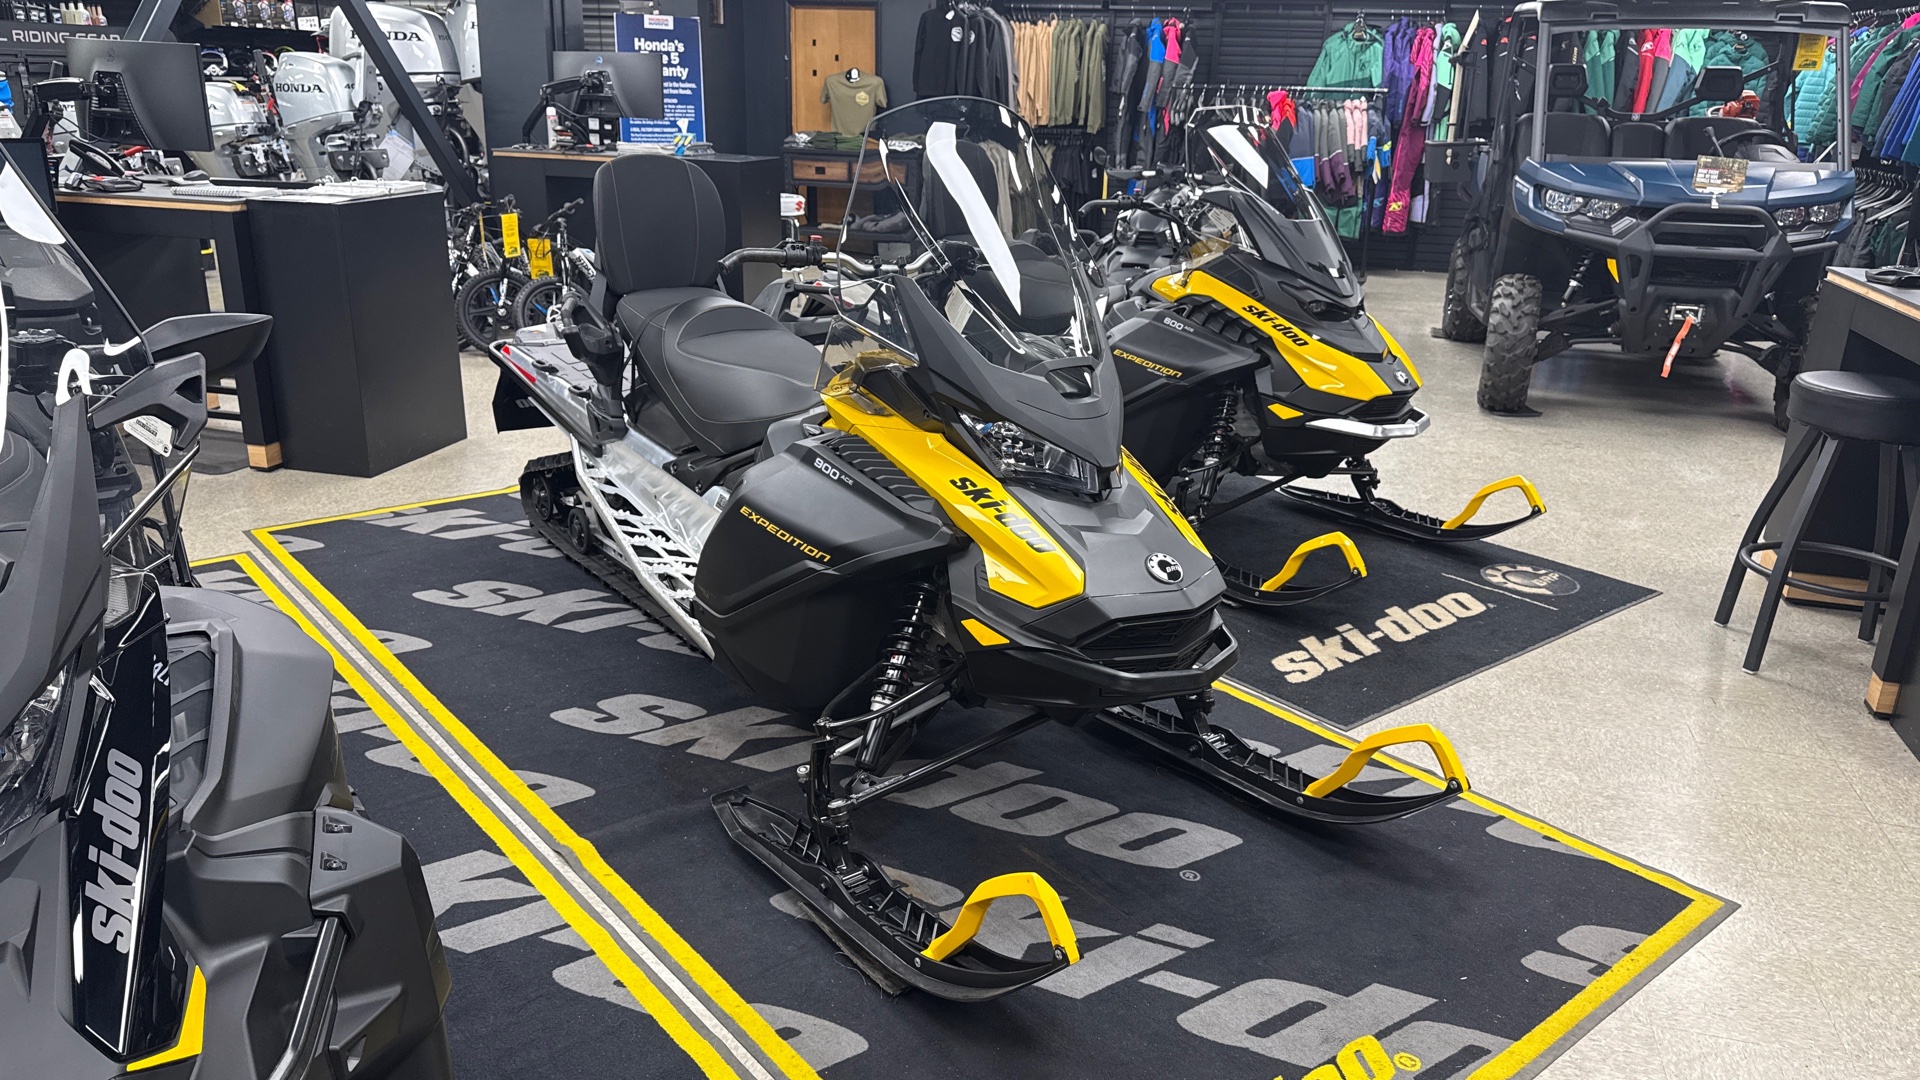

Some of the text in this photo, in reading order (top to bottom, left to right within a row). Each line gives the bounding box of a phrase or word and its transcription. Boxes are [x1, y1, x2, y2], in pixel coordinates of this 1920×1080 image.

[634, 37, 685, 53] Honda's
[670, 52, 680, 64] 5
[275, 82, 325, 93] HONDA
[1163, 317, 1184, 331] 600
[1242, 304, 1310, 348] ski-doo
[1113, 349, 1182, 378] EXPEDITION
[813, 457, 854, 486] 900 ACE
[949, 476, 1057, 554] ski-doo
[739, 505, 831, 563] EXPEDITION
[1271, 592, 1487, 684] ski-doo
[85, 748, 143, 955] ski-doo
